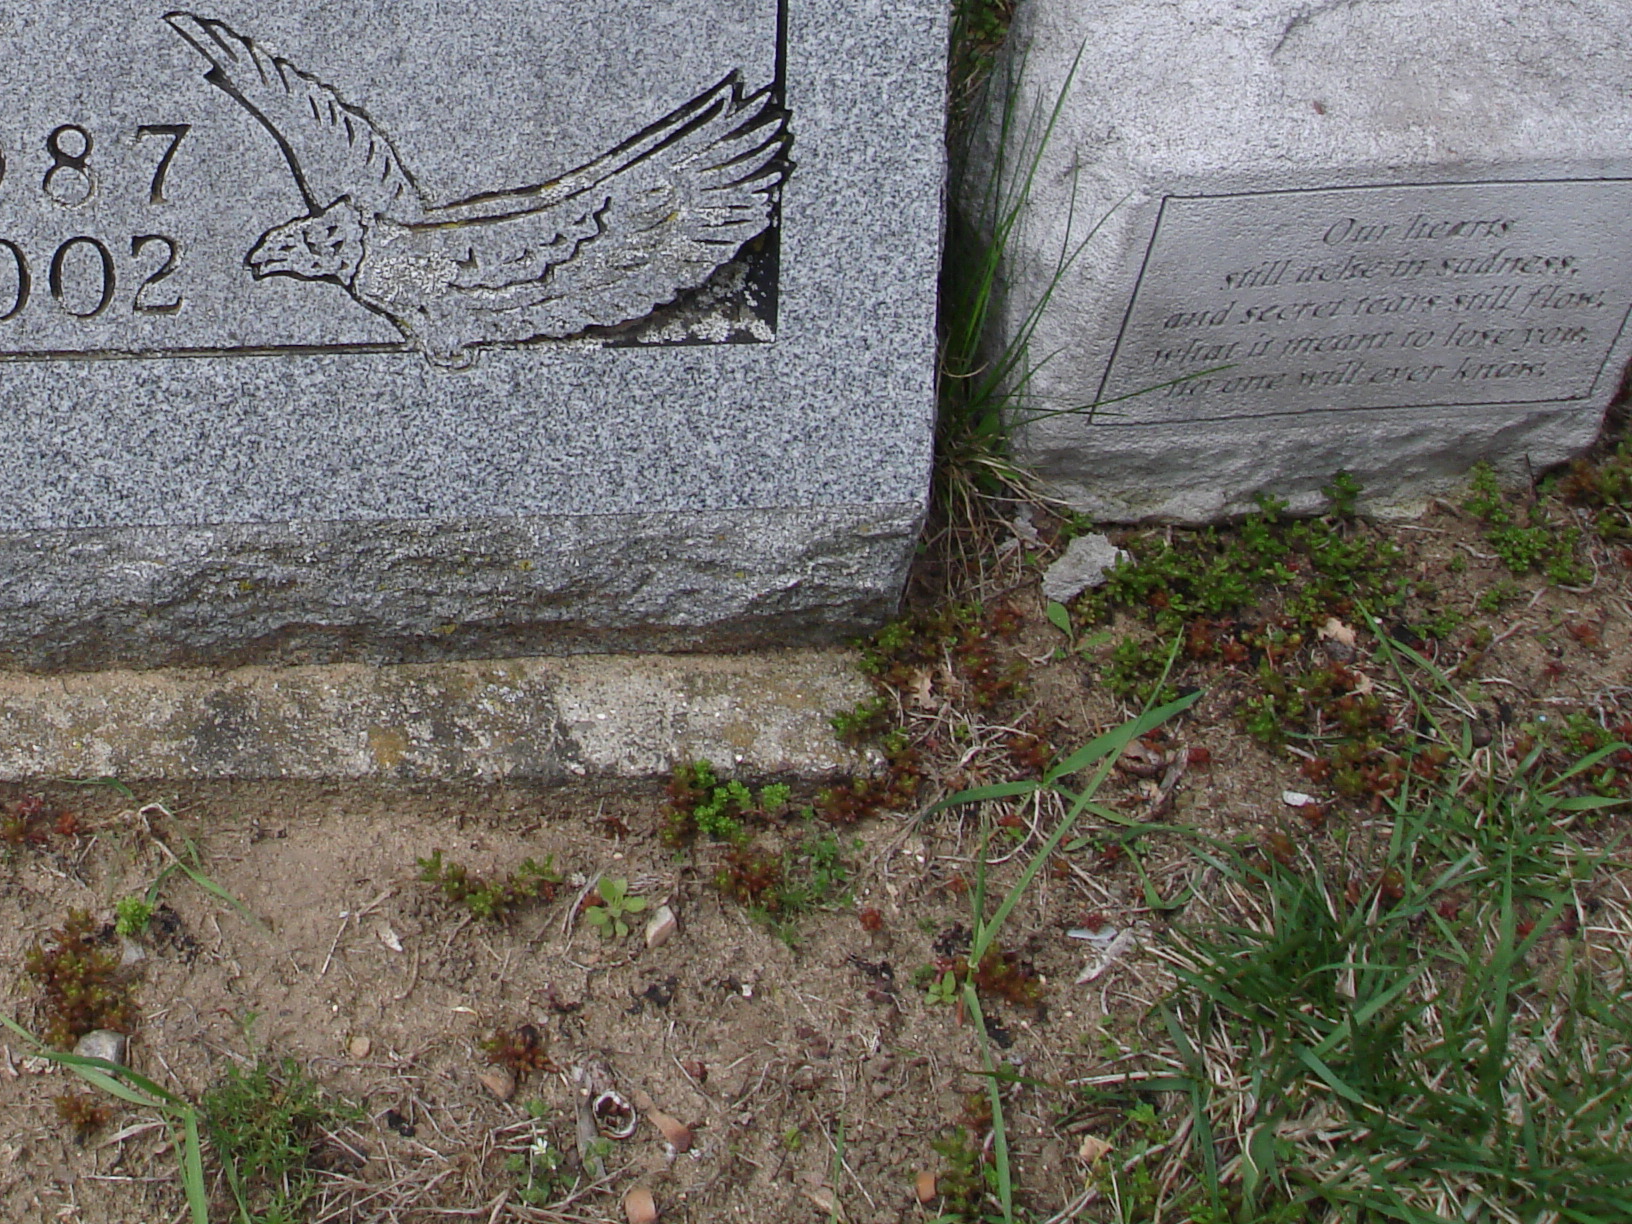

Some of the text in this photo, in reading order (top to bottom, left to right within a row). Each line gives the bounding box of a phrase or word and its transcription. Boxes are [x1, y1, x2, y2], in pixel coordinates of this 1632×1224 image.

[1322, 213, 1516, 247] Our hearts
[1218, 259, 1294, 291] still
[1294, 255, 1385, 284] ache
[1390, 251, 1430, 277] in
[1163, 300, 1237, 329] and
[1239, 299, 1346, 325] secret
[1353, 294, 1442, 316] tears
[1446, 284, 1522, 313] still
[1150, 338, 1241, 368] what
[1244, 333, 1276, 358] it
[1280, 331, 1395, 359] meant
[1398, 329, 1436, 349] to
[1164, 378, 1214, 399] no
[1218, 372, 1290, 395] one
[1298, 360, 1368, 386] will
[1368, 364, 1446, 384] ever
